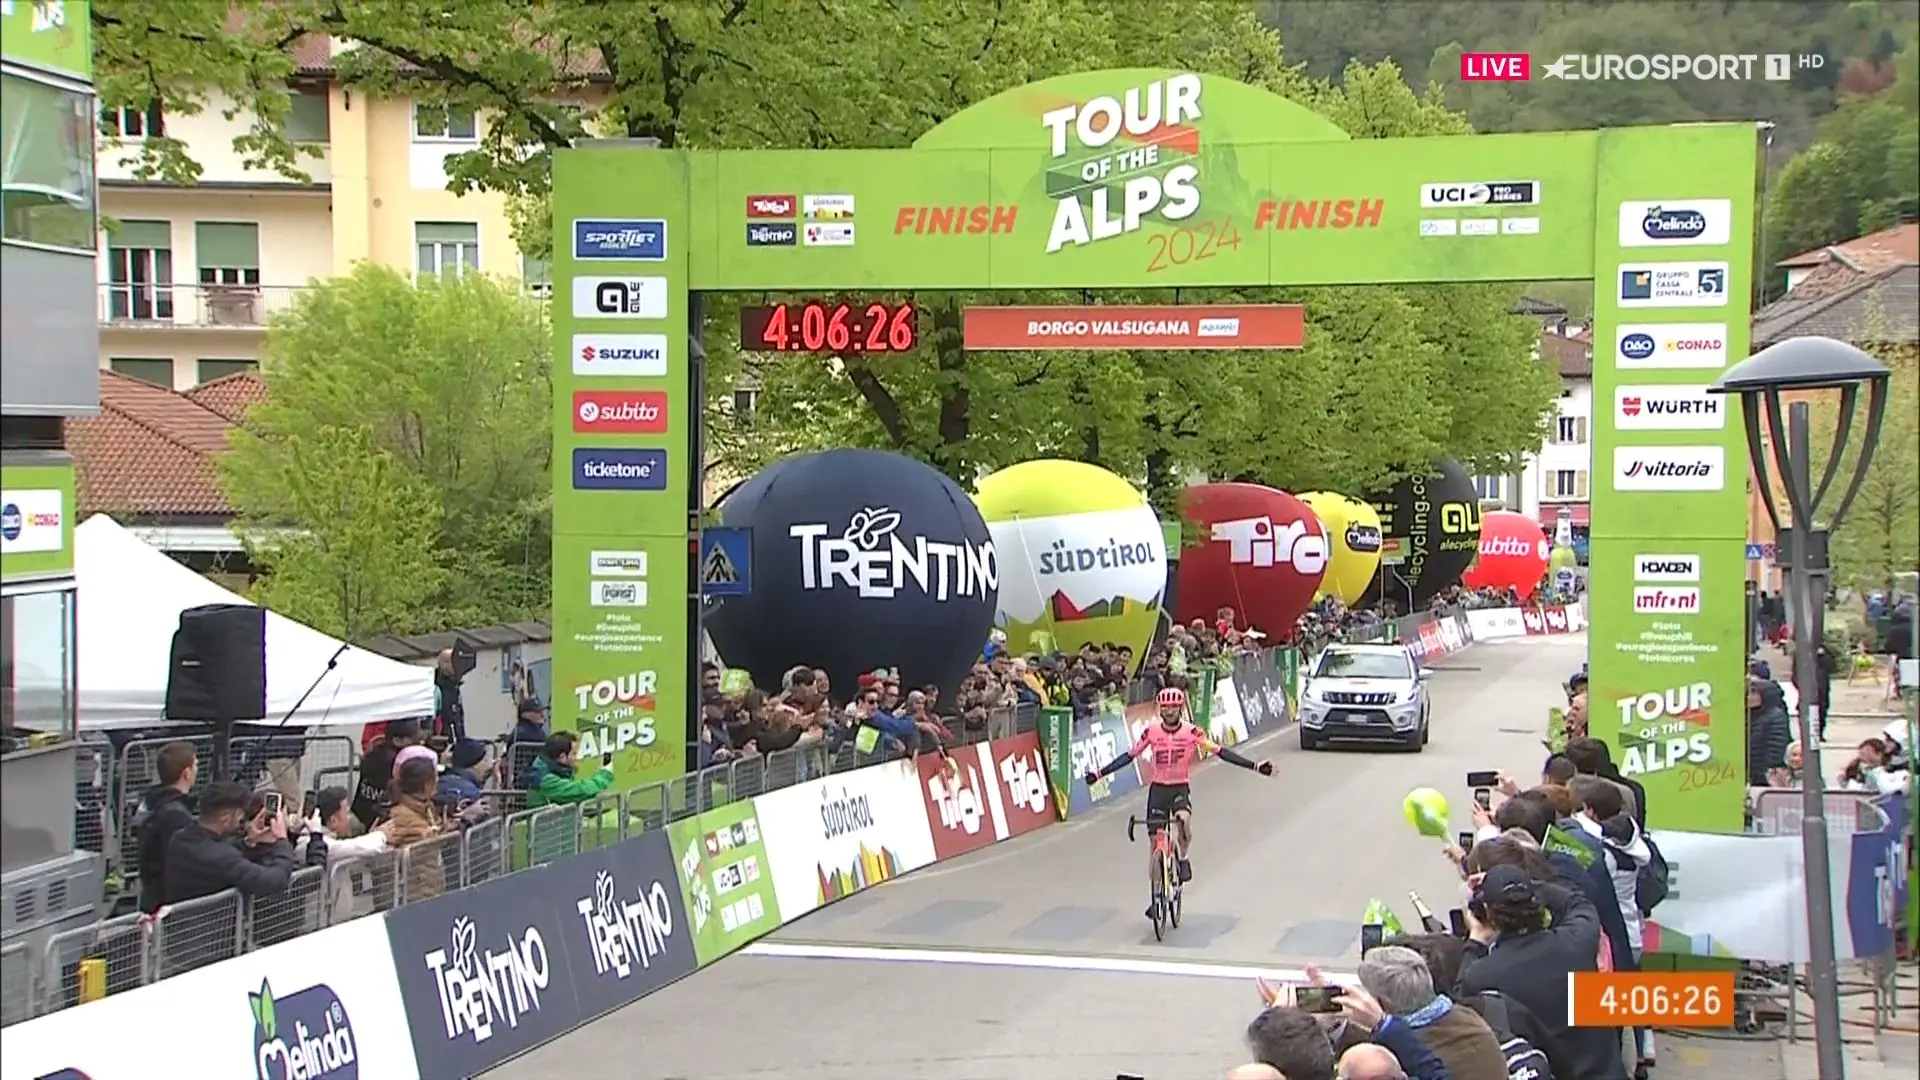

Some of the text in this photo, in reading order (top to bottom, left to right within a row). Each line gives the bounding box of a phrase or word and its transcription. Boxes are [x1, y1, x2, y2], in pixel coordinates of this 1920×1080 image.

[1042, 73, 1202, 158] TOUR
[1081, 145, 1159, 183] OF THE
[1431, 187, 1466, 202] UCI
[894, 206, 1018, 234] FINISH
[1044, 165, 1201, 254] ALPS
[1255, 198, 1385, 231] FINISH
[1644, 215, 1704, 232] Melinda
[584, 229, 656, 247] SPORTLER
[1146, 215, 1242, 274] 2024
[1656, 271, 1690, 279] GRUPPO
[1656, 289, 1693, 297] CENTRALE
[763, 304, 912, 350] 4:06:26
[1027, 321, 1088, 336] BORGO
[1092, 320, 1190, 336] VALSUGANA
[600, 349, 659, 360] SUZUKI
[1624, 340, 1653, 351] DAO
[1676, 340, 1722, 350] CONAD
[601, 402, 659, 421] subito
[1647, 400, 1717, 414] WÜRTH
[1645, 461, 1711, 477] vittoria
[790, 523, 1000, 602] TRENTINO
[1641, 562, 1692, 573] HOWDEN
[575, 670, 657, 711] TOUR
[1616, 681, 1712, 725] TOUR
[594, 706, 635, 724] OF THE
[576, 717, 657, 760] ALPS
[1640, 720, 1686, 739] OF THE
[628, 746, 676, 773] 2024
[1618, 732, 1712, 778] ALPS
[999, 749, 1050, 814] Tirol
[1678, 761, 1735, 793] 2024
[577, 881, 673, 979] TRENTINO
[425, 926, 550, 1043] TRENTINO
[259, 1010, 356, 1080] Melinda
